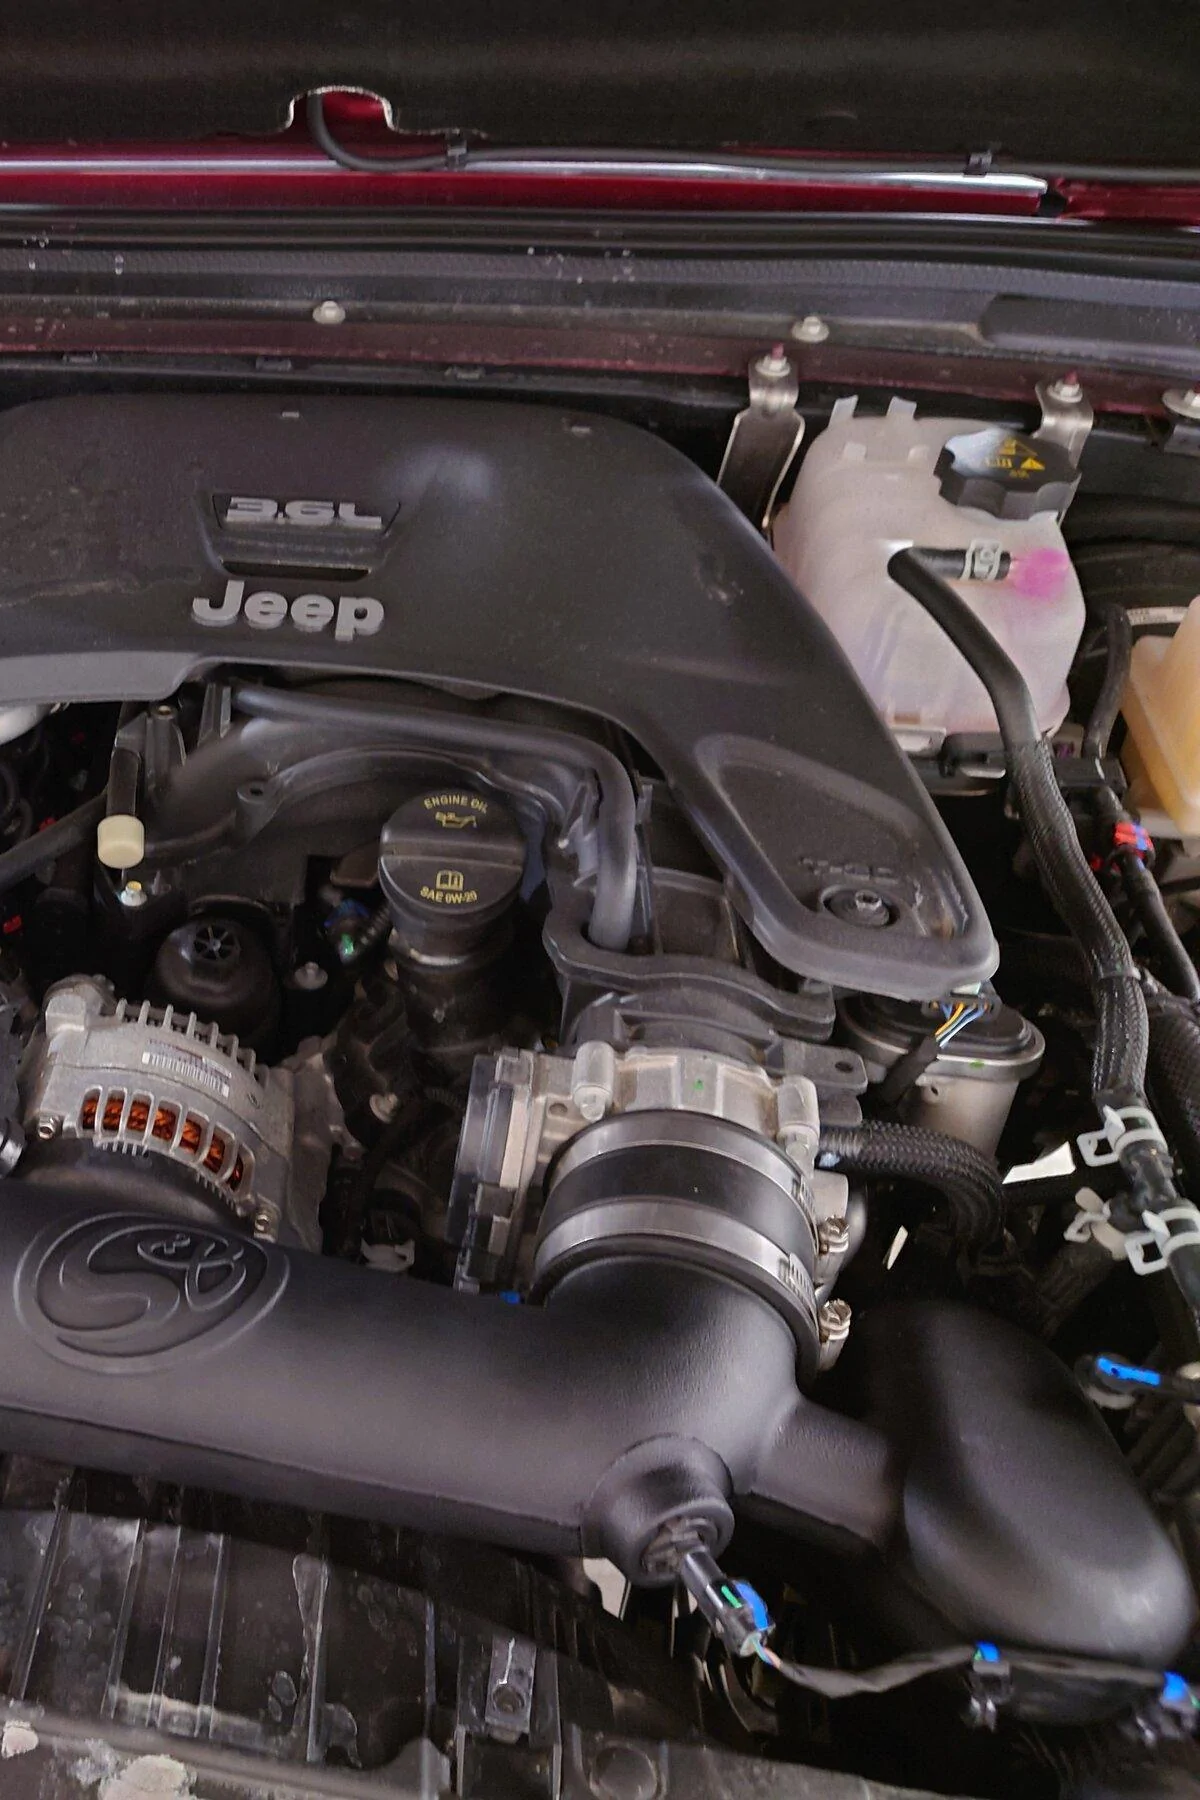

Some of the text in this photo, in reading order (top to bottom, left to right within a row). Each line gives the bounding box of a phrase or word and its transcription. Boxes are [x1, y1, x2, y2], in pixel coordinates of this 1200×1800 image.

[226, 496, 382, 530] 3.6L
[191, 579, 385, 642] Jeep
[423, 794, 488, 815] ENGINE OIL
[420, 885, 444, 903] SAE
